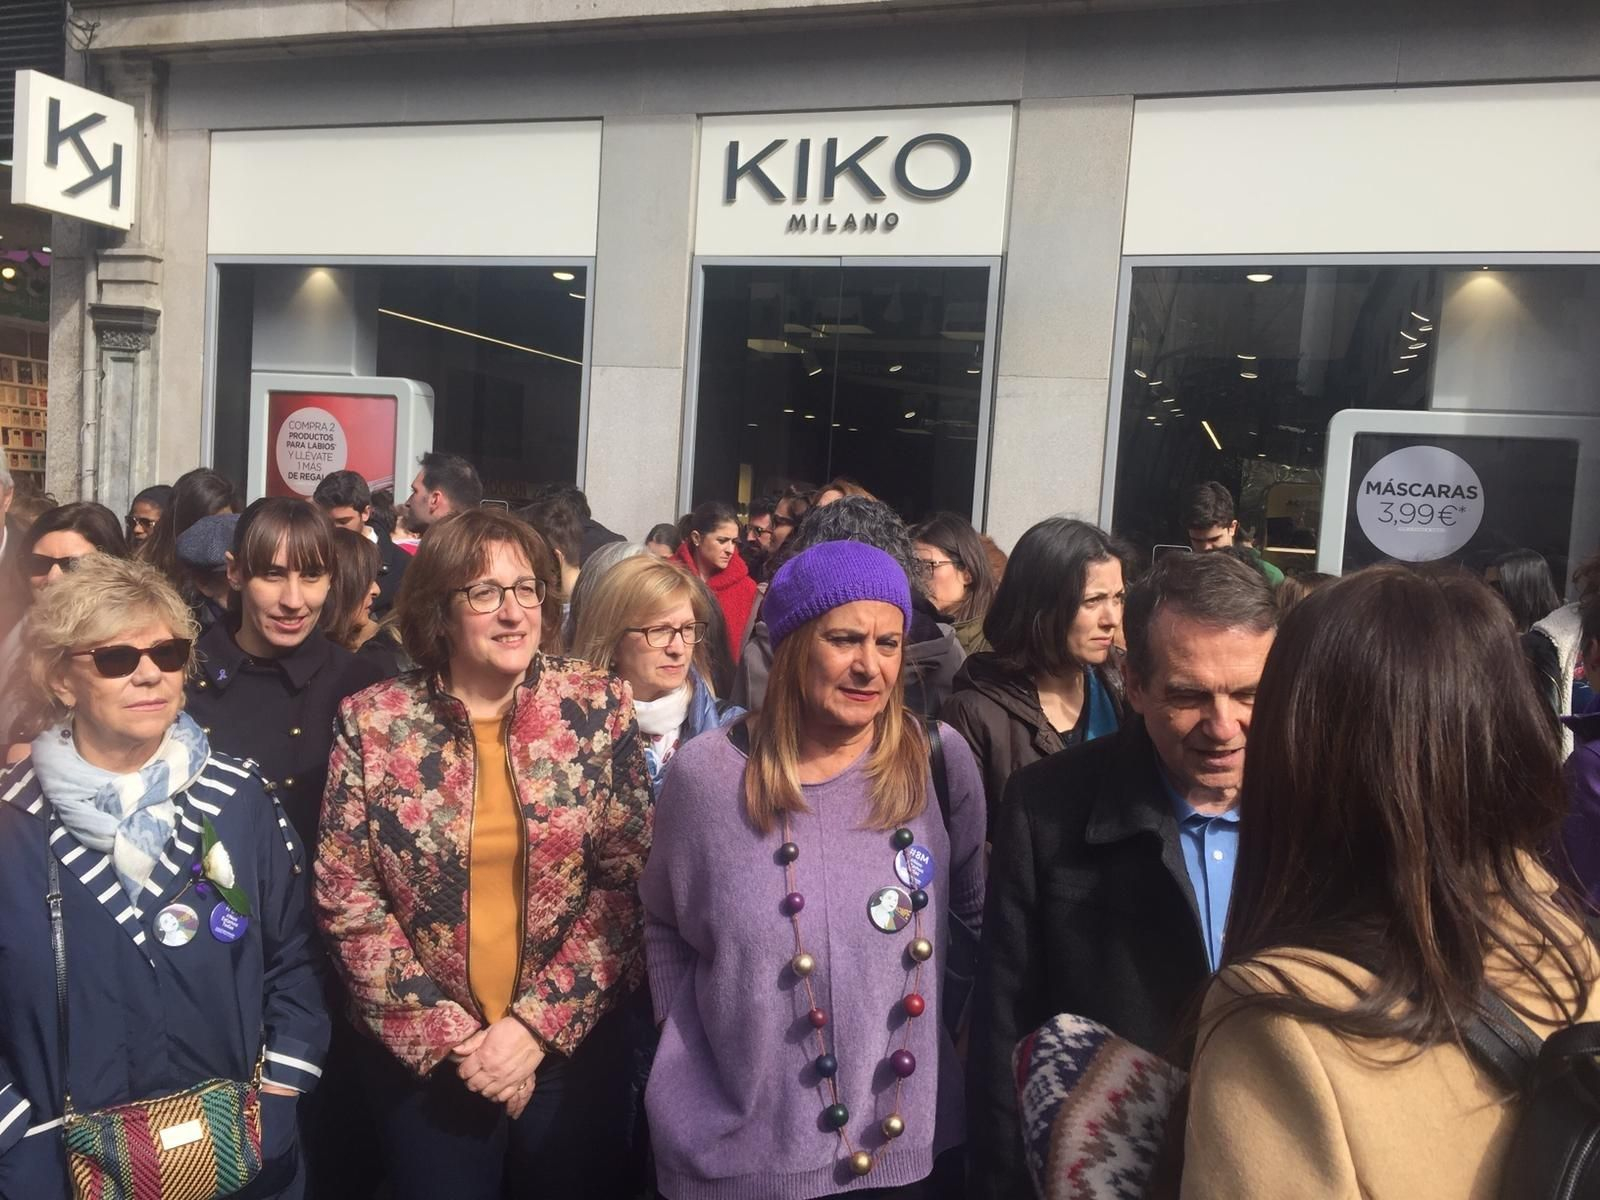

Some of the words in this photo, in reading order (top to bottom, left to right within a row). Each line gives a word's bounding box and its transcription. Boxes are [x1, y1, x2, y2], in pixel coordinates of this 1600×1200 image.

[725, 132, 972, 201] KIKO
[788, 212, 899, 231] MILANO
[288, 421, 328, 431] COMPRA
[329, 422, 336, 432] 2
[288, 432, 334, 441] PRODUCTOS
[286, 441, 306, 449] PARA
[288, 450, 294, 460] Y
[287, 472, 299, 480] DE
[300, 473, 325, 481] REGAL
[1365, 478, 1478, 499] MÁSCARAS
